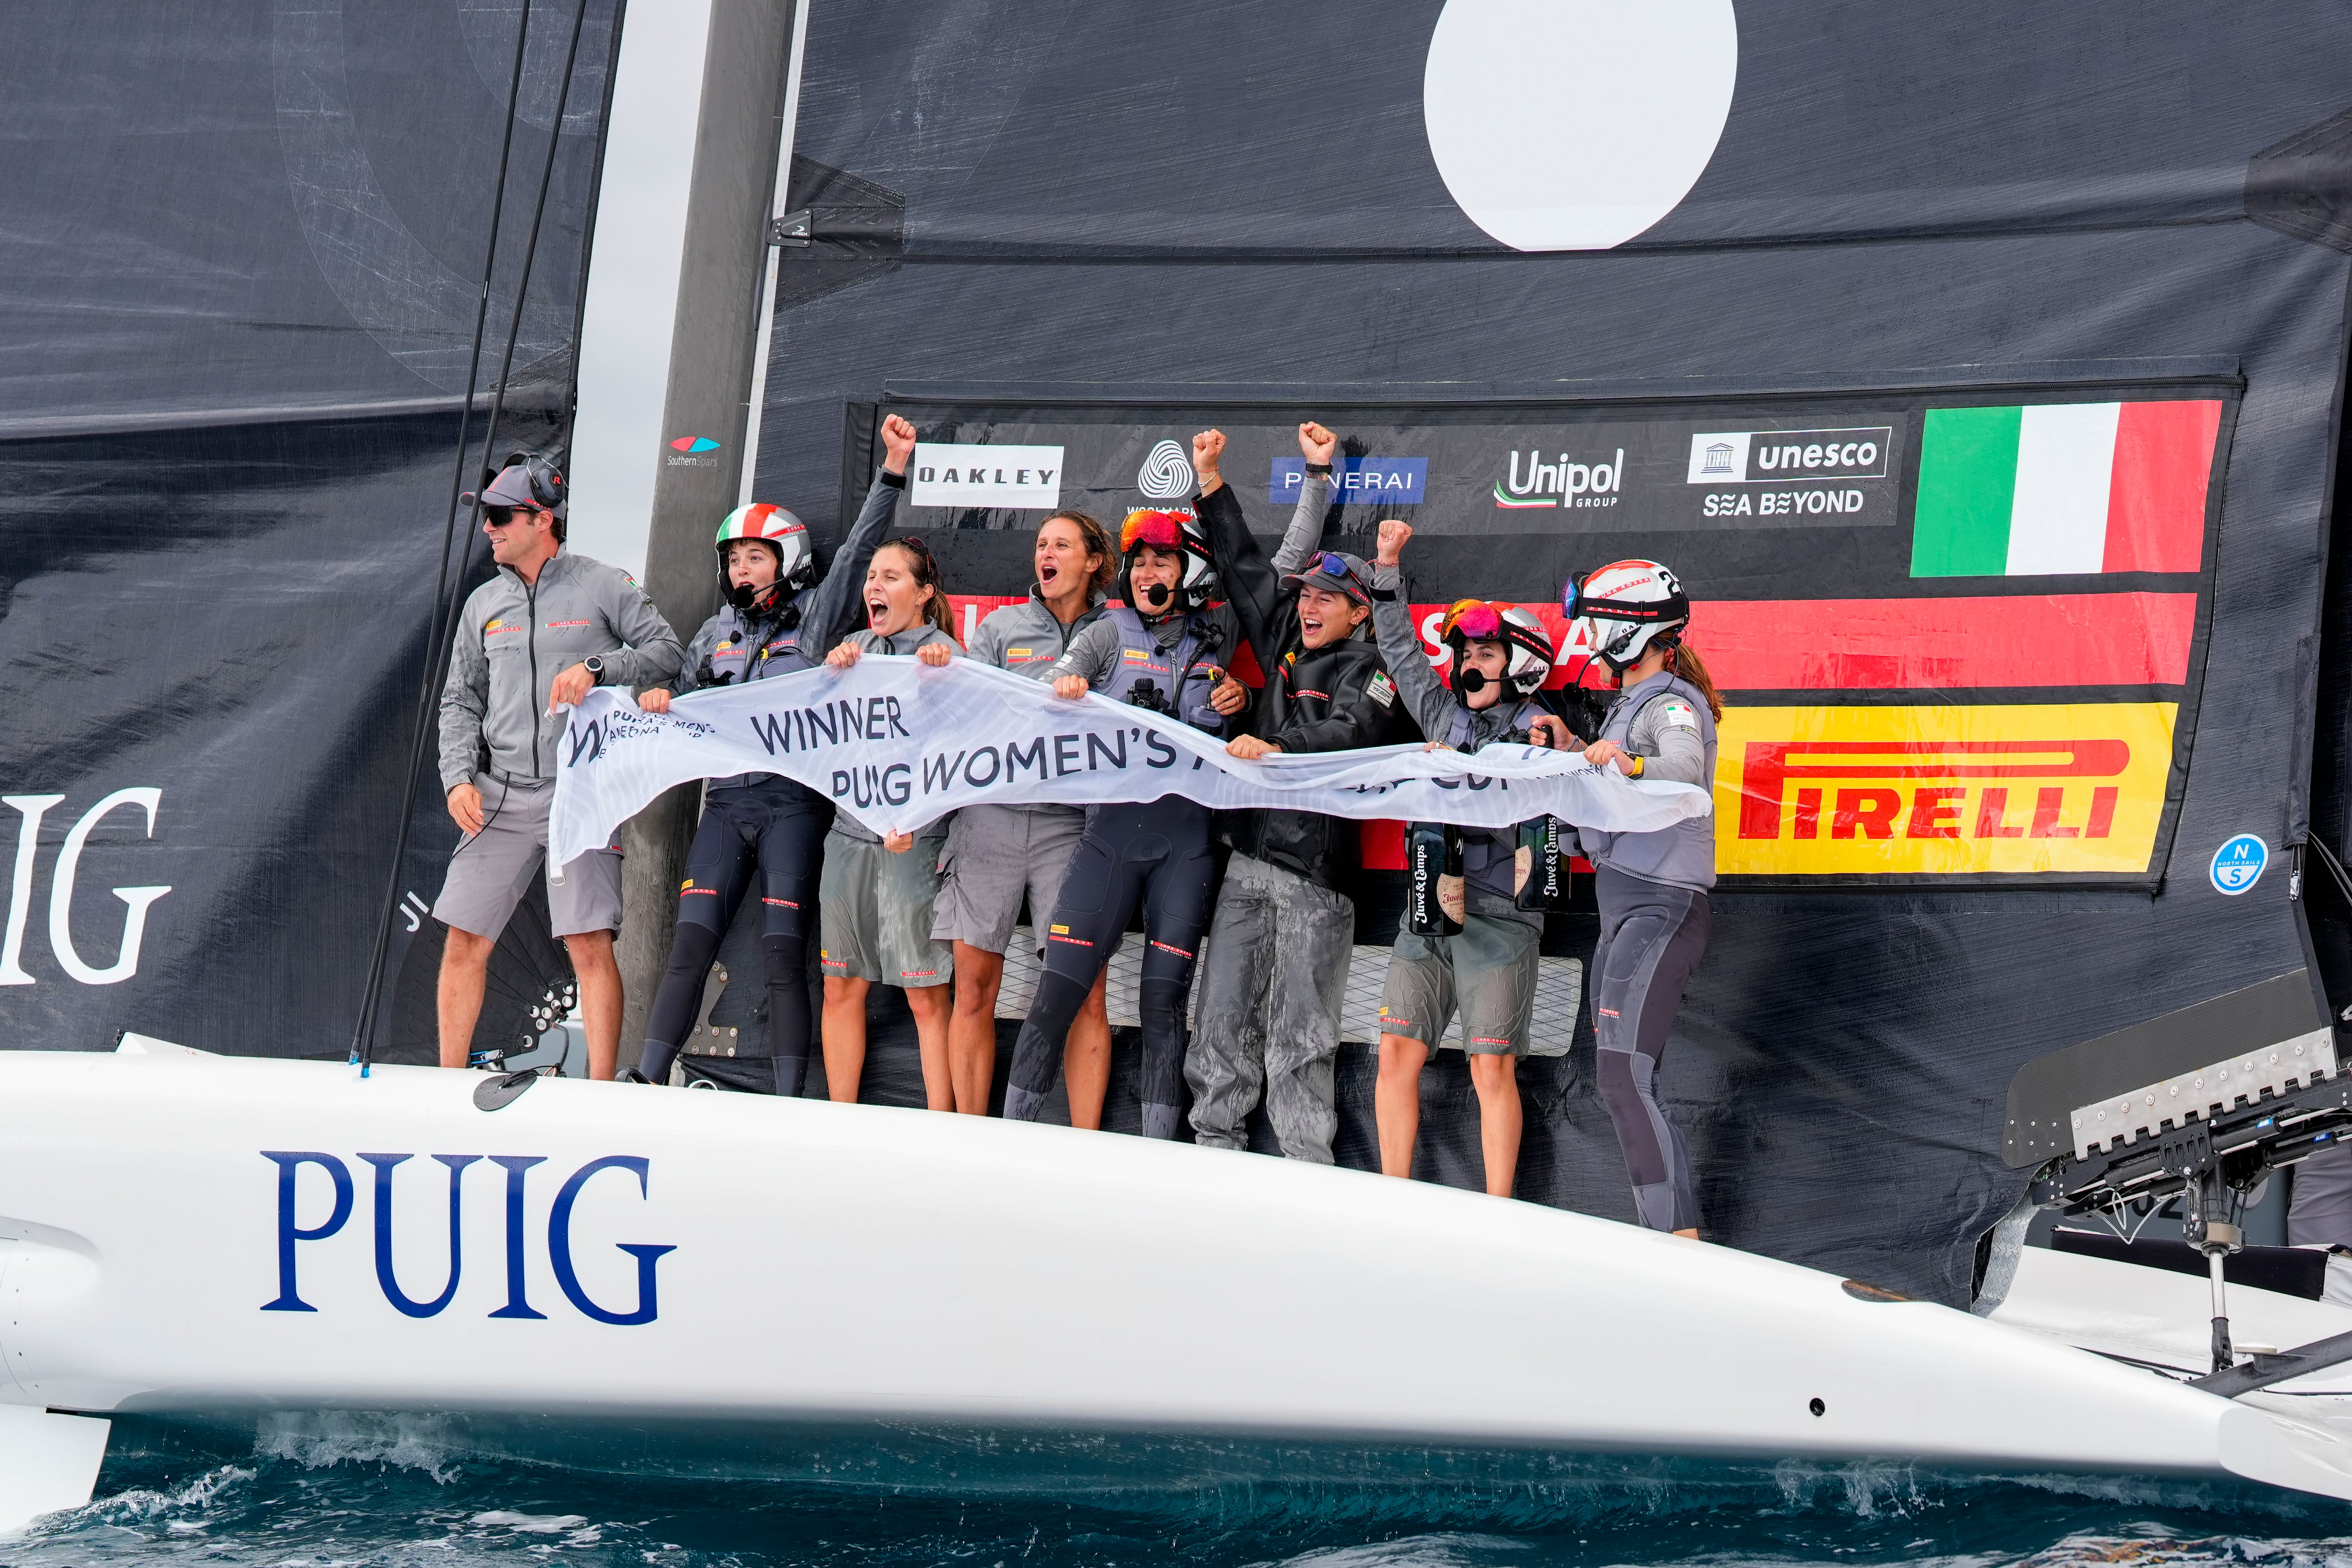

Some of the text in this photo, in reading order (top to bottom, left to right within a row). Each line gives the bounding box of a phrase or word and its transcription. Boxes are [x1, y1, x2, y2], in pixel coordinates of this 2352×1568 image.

[1705, 451, 1732, 467] UNESCO
[1759, 442, 1877, 469] unesco
[919, 467, 1054, 484] OAKLEY
[1285, 472, 1412, 489] PNERAI
[1509, 448, 1624, 508] Unipol
[1576, 497, 1618, 508] GROUP
[1703, 490, 1864, 517] SEA BEYOND
[1601, 577, 1650, 599] UNA ROSSA
[1513, 632, 1541, 649] PRADA
[1143, 662, 1166, 671] PRADA
[750, 696, 910, 755] WINNER
[833, 763, 911, 808] PUIG
[1738, 739, 2130, 839] PIRELLI
[2233, 844, 2249, 859] N
[2229, 869, 2241, 884] S
[260, 1150, 677, 1326] PUIG
